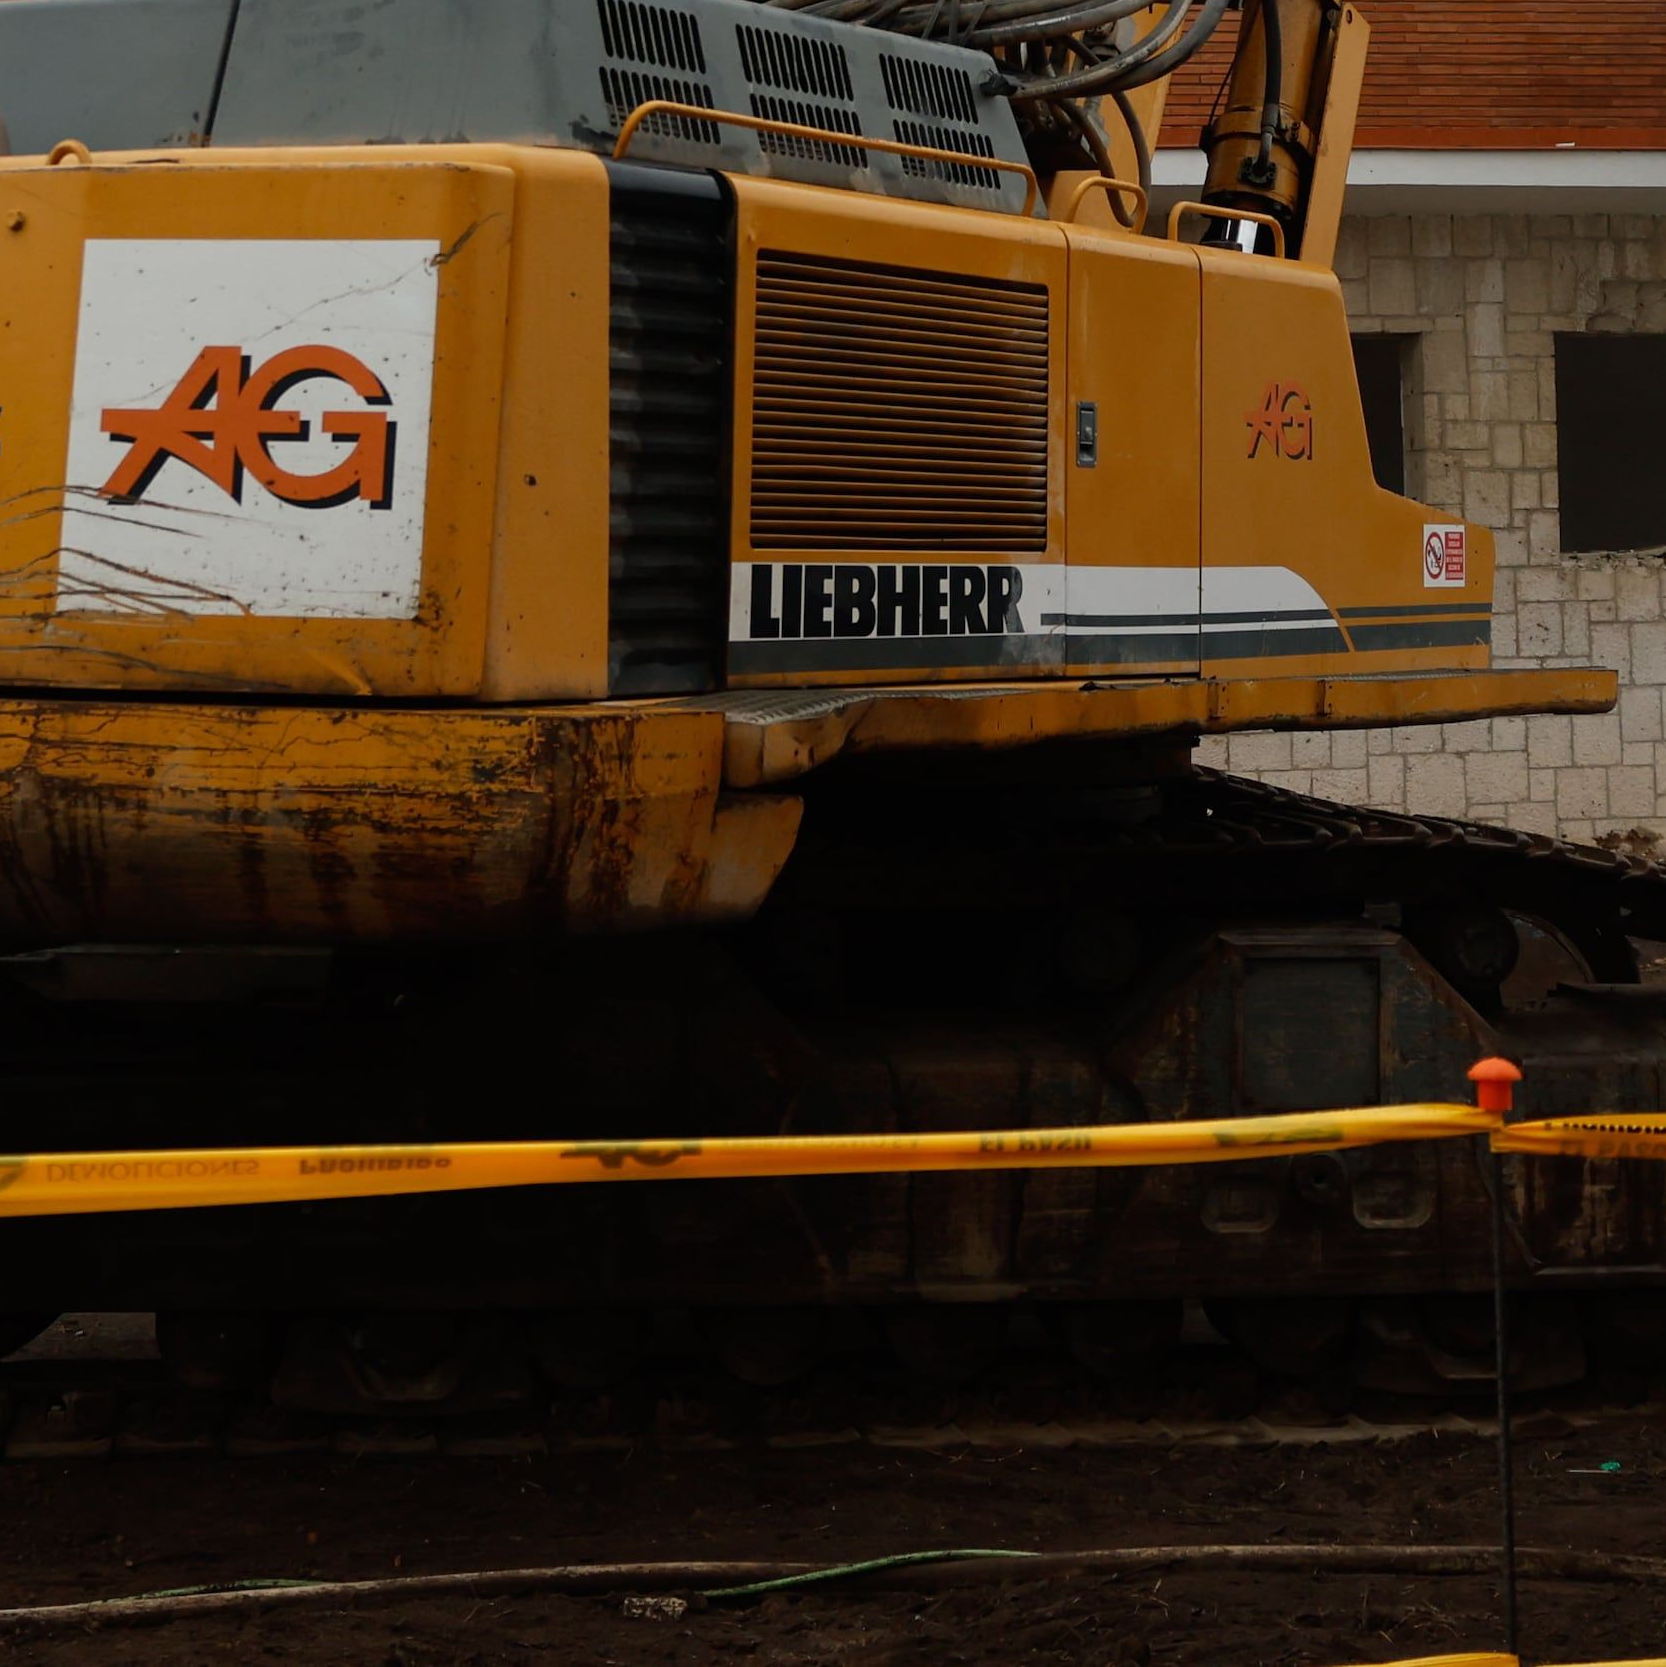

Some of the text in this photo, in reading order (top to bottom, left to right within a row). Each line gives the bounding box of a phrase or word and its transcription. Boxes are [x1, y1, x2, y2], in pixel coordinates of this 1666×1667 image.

[97, 344, 398, 511] AG
[1243, 380, 1313, 461] AG
[749, 564, 1025, 639] LIEBHERR
